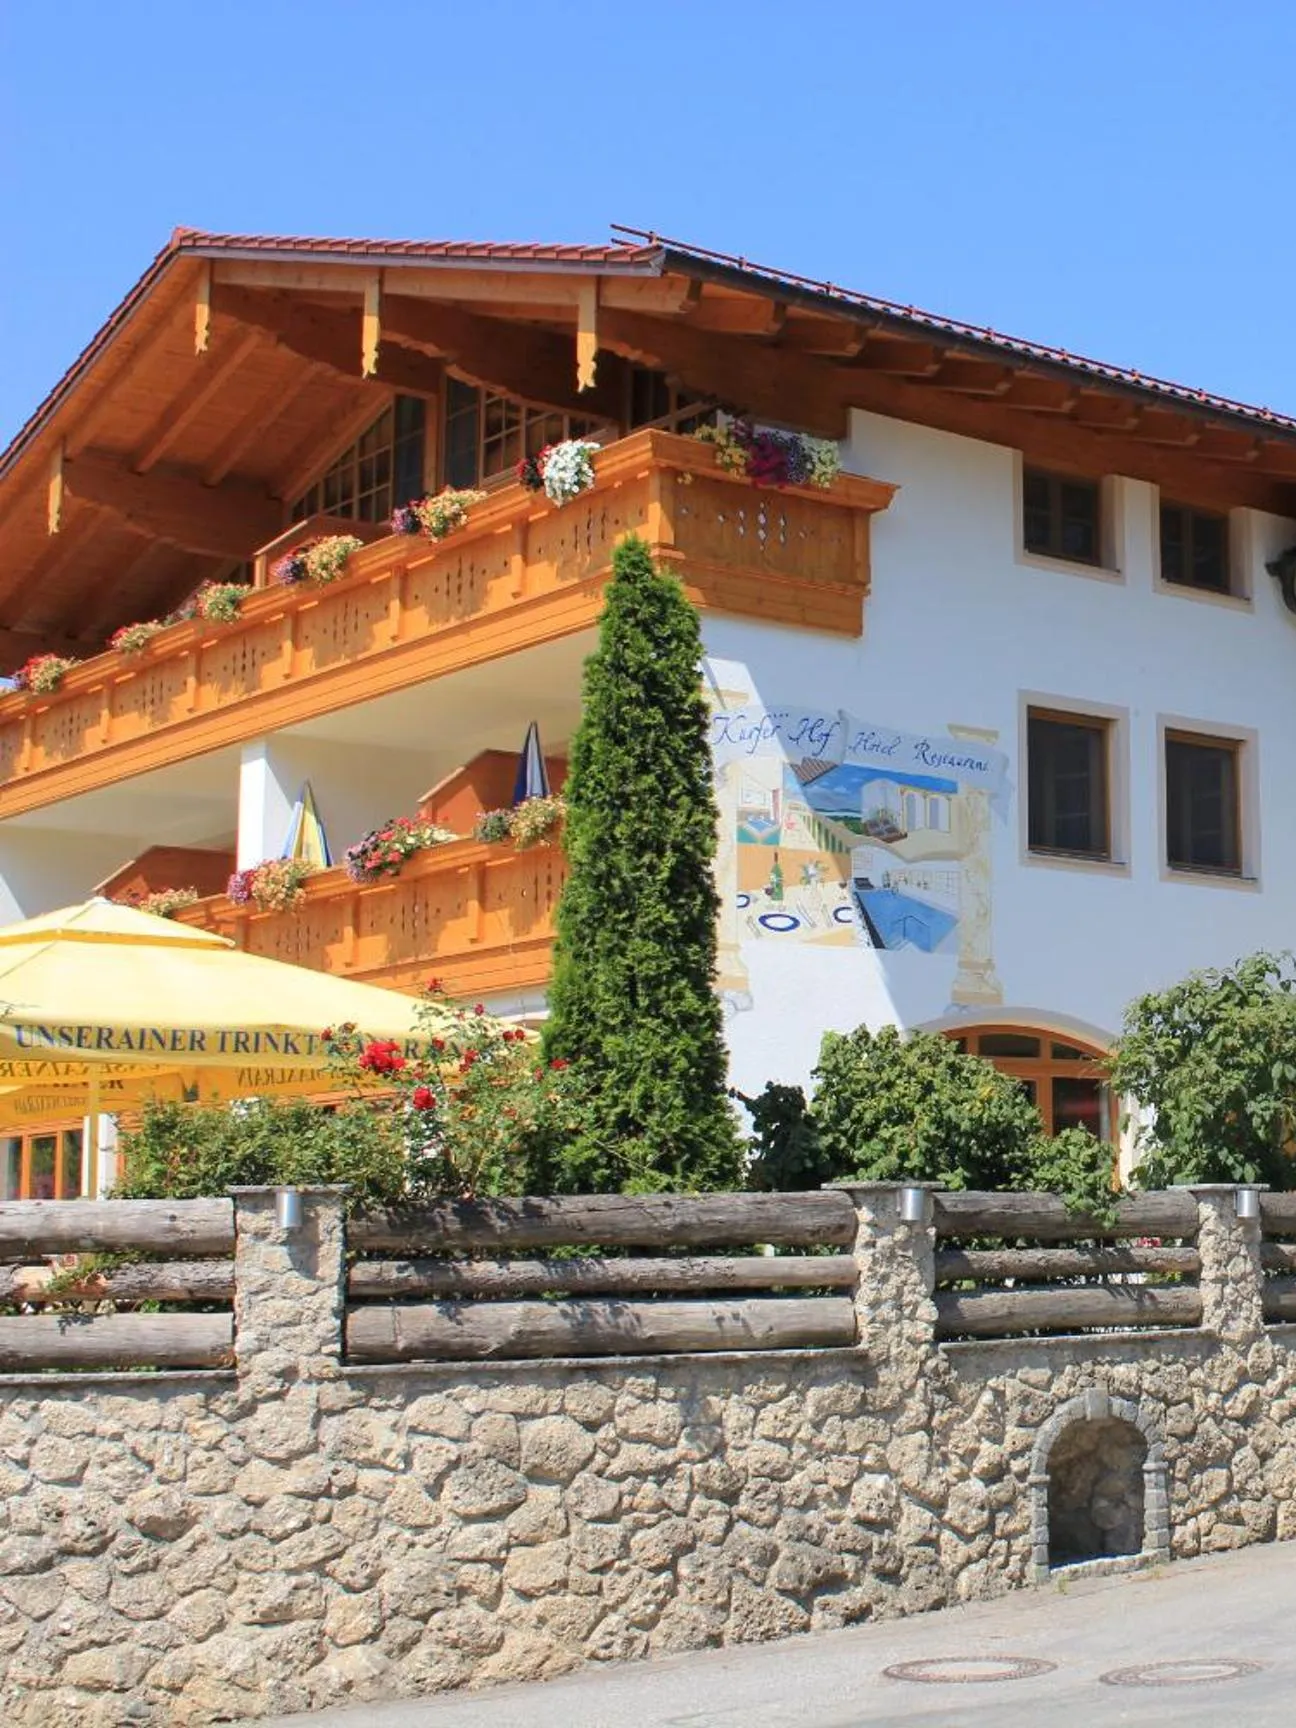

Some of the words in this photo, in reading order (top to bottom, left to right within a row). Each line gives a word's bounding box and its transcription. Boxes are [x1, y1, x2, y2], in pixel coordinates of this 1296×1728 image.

[787, 717, 841, 757] Hof
[848, 731, 902, 756] Hotel
[912, 738, 989, 772] Restaurant
[14, 1023, 207, 1052] UNSERAINER
[215, 1029, 322, 1056] TRINKT
